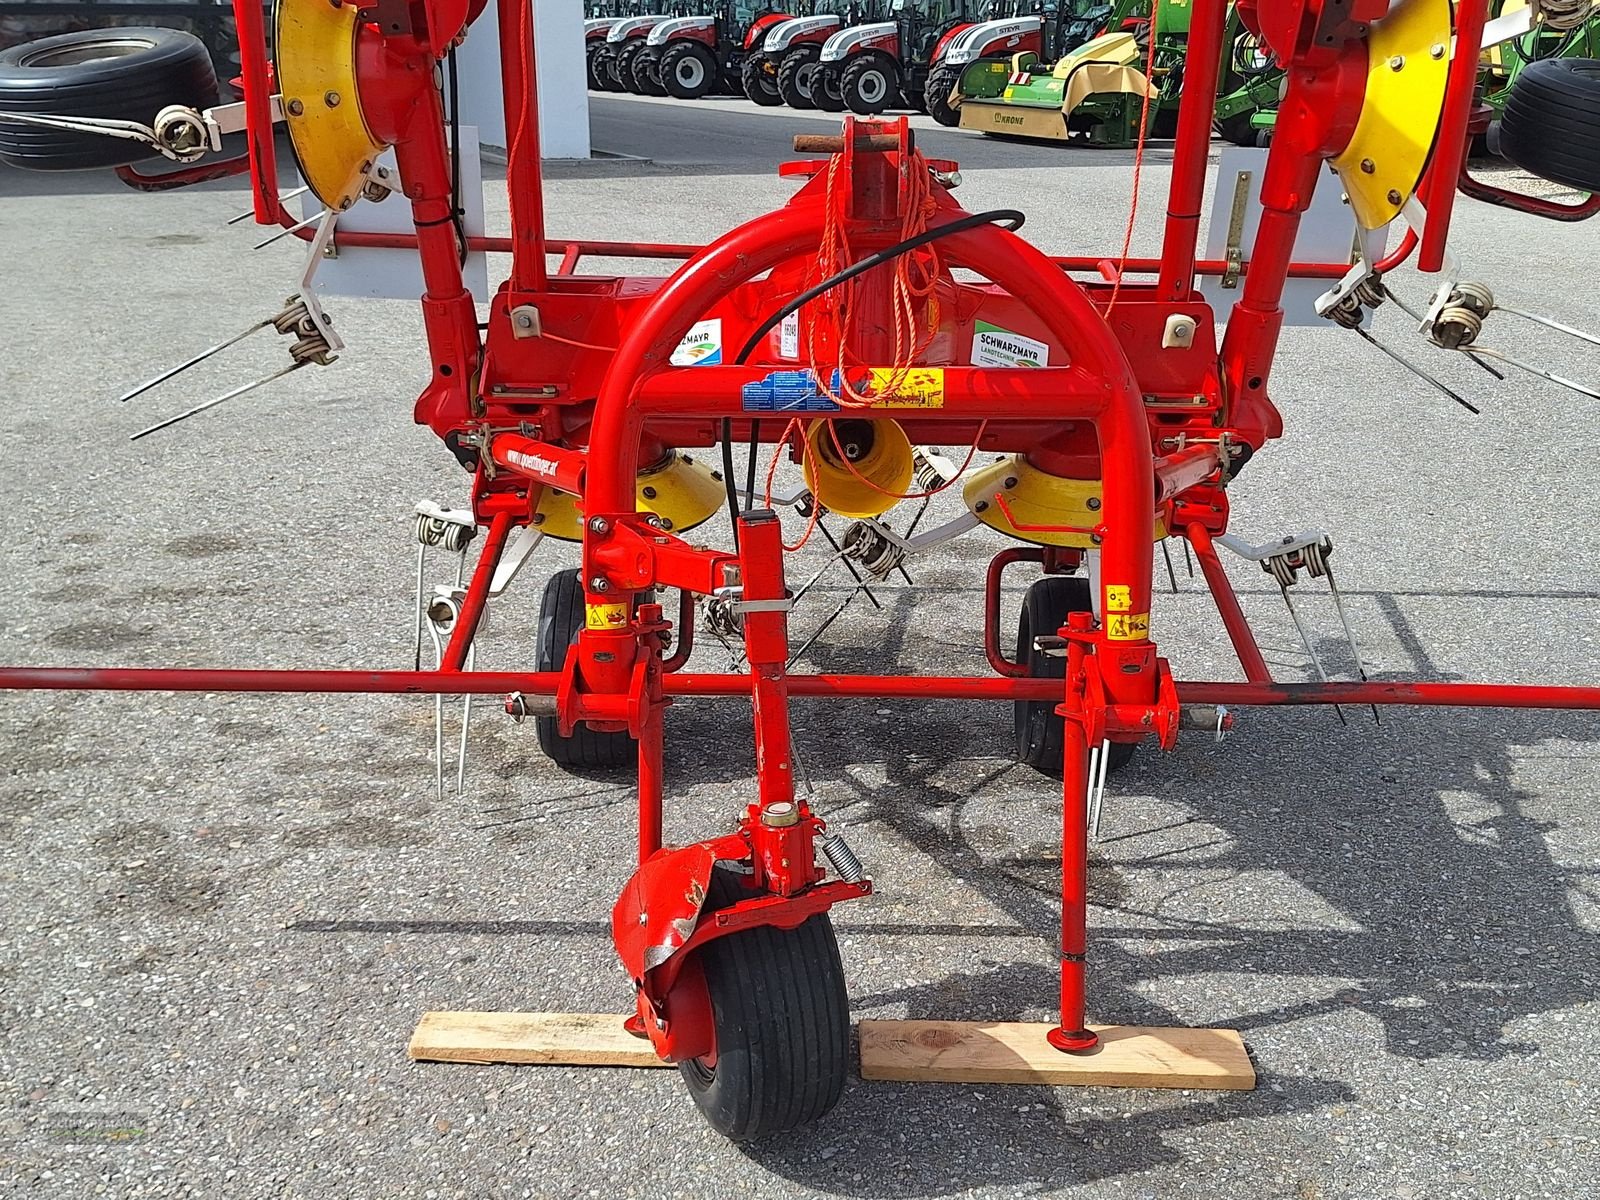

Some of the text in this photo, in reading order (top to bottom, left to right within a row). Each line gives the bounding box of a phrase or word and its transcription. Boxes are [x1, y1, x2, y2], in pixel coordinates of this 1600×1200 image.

[861, 29, 880, 37] STEYR
[998, 25, 1021, 35] STEYR
[1001, 115, 1024, 125] KRONE
[680, 332, 709, 346] ZMAYR
[980, 333, 1038, 361] SCHWARZMAYR
[981, 346, 1015, 363] LANDTECHNIK
